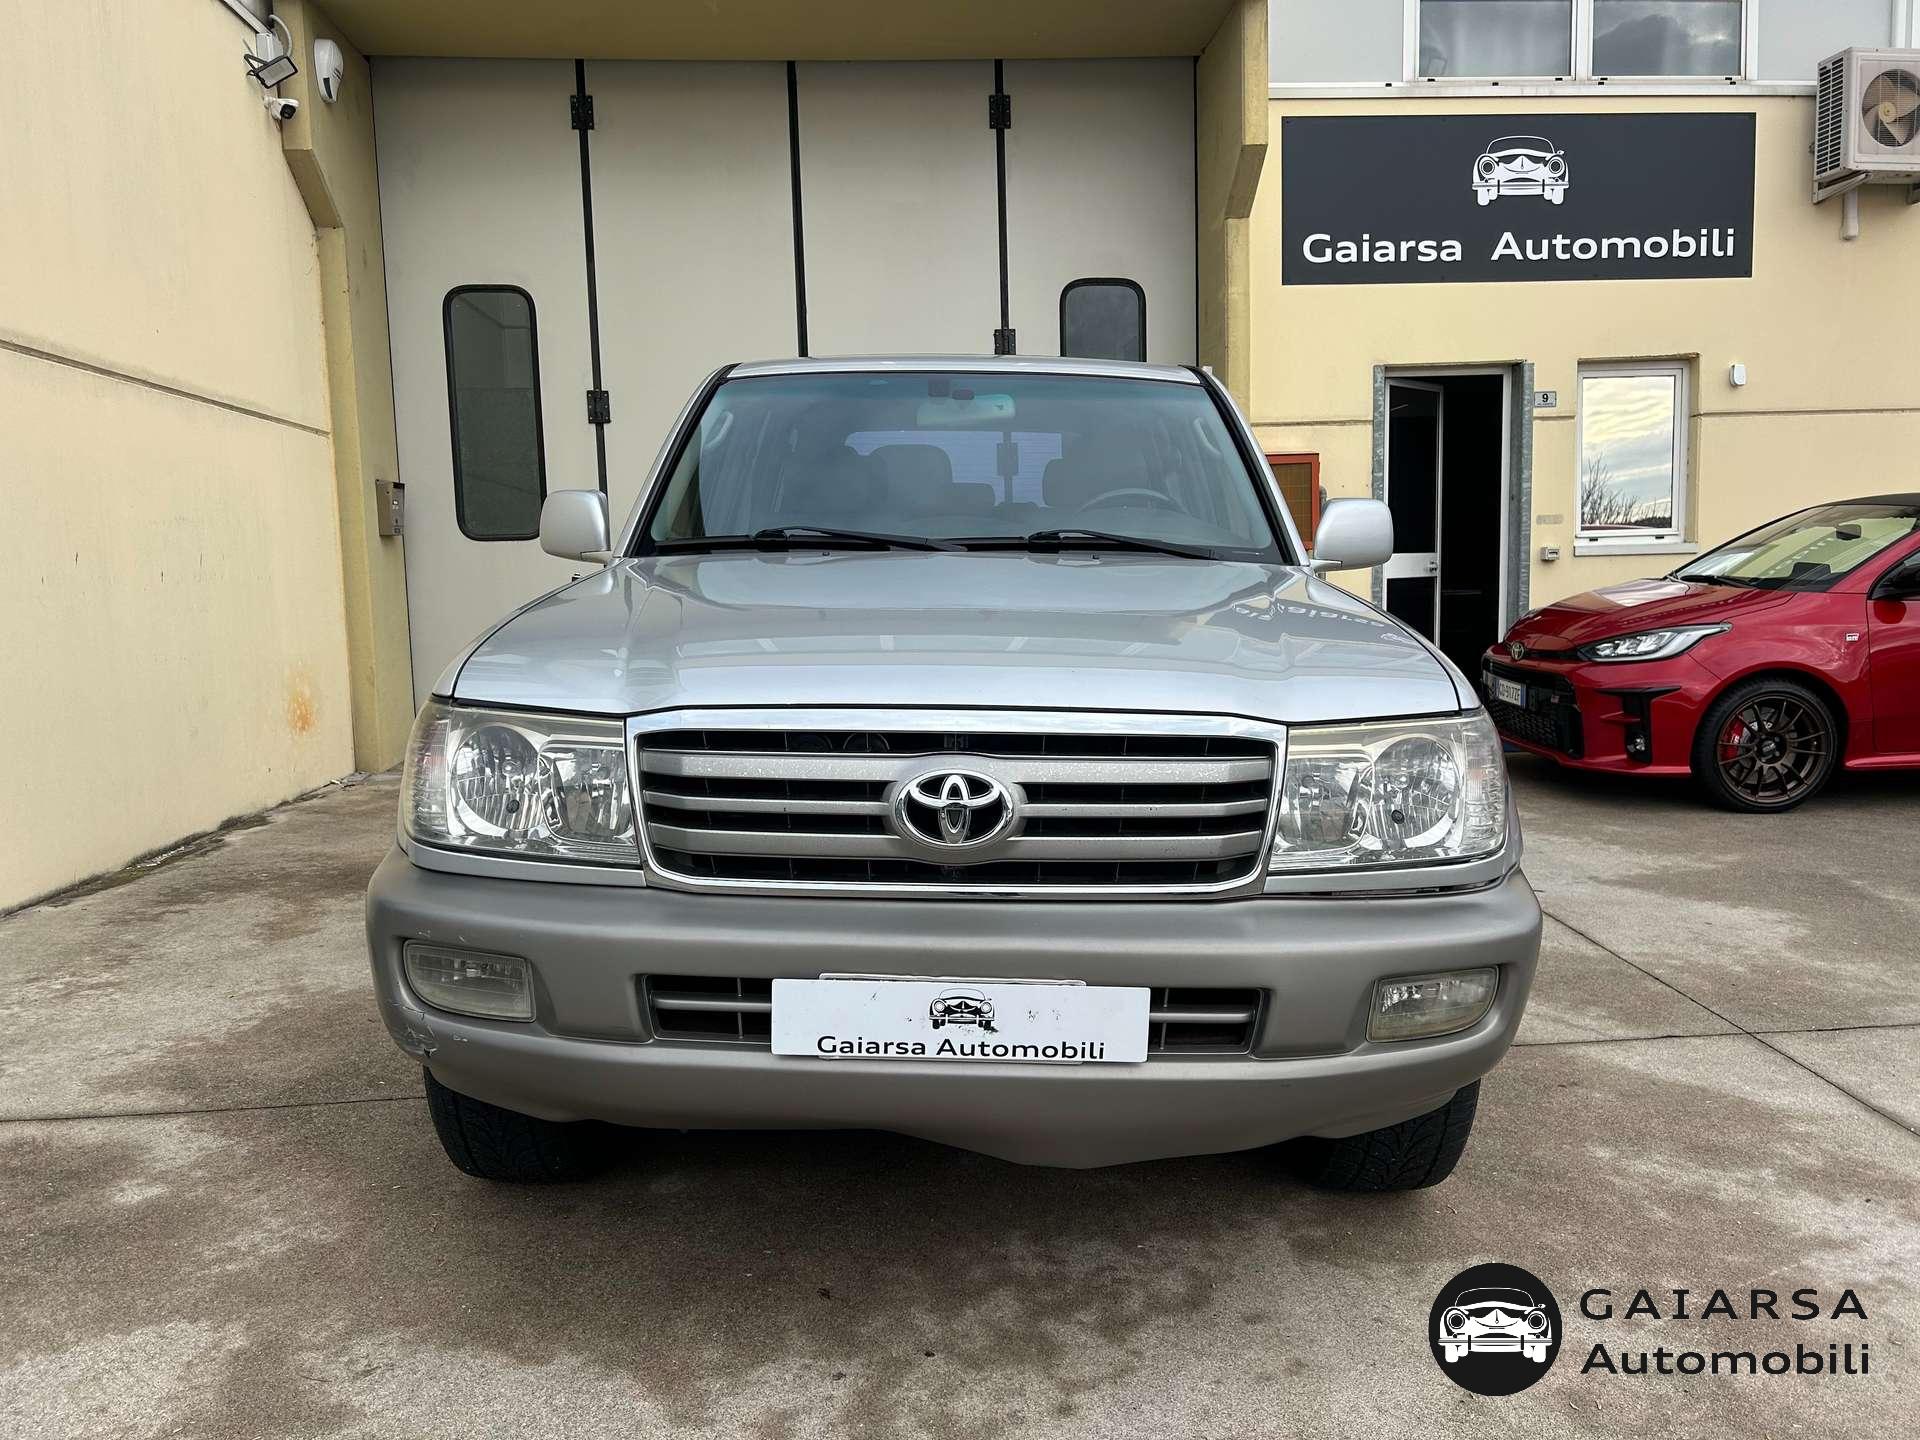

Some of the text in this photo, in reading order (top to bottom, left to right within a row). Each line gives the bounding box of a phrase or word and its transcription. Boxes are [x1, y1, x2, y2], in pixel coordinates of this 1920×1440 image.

[1302, 228, 1735, 264] Gaiarsa Automobili
[1541, 393, 1549, 403] 9
[817, 1035, 1105, 1060] Gaiarsa Automobili
